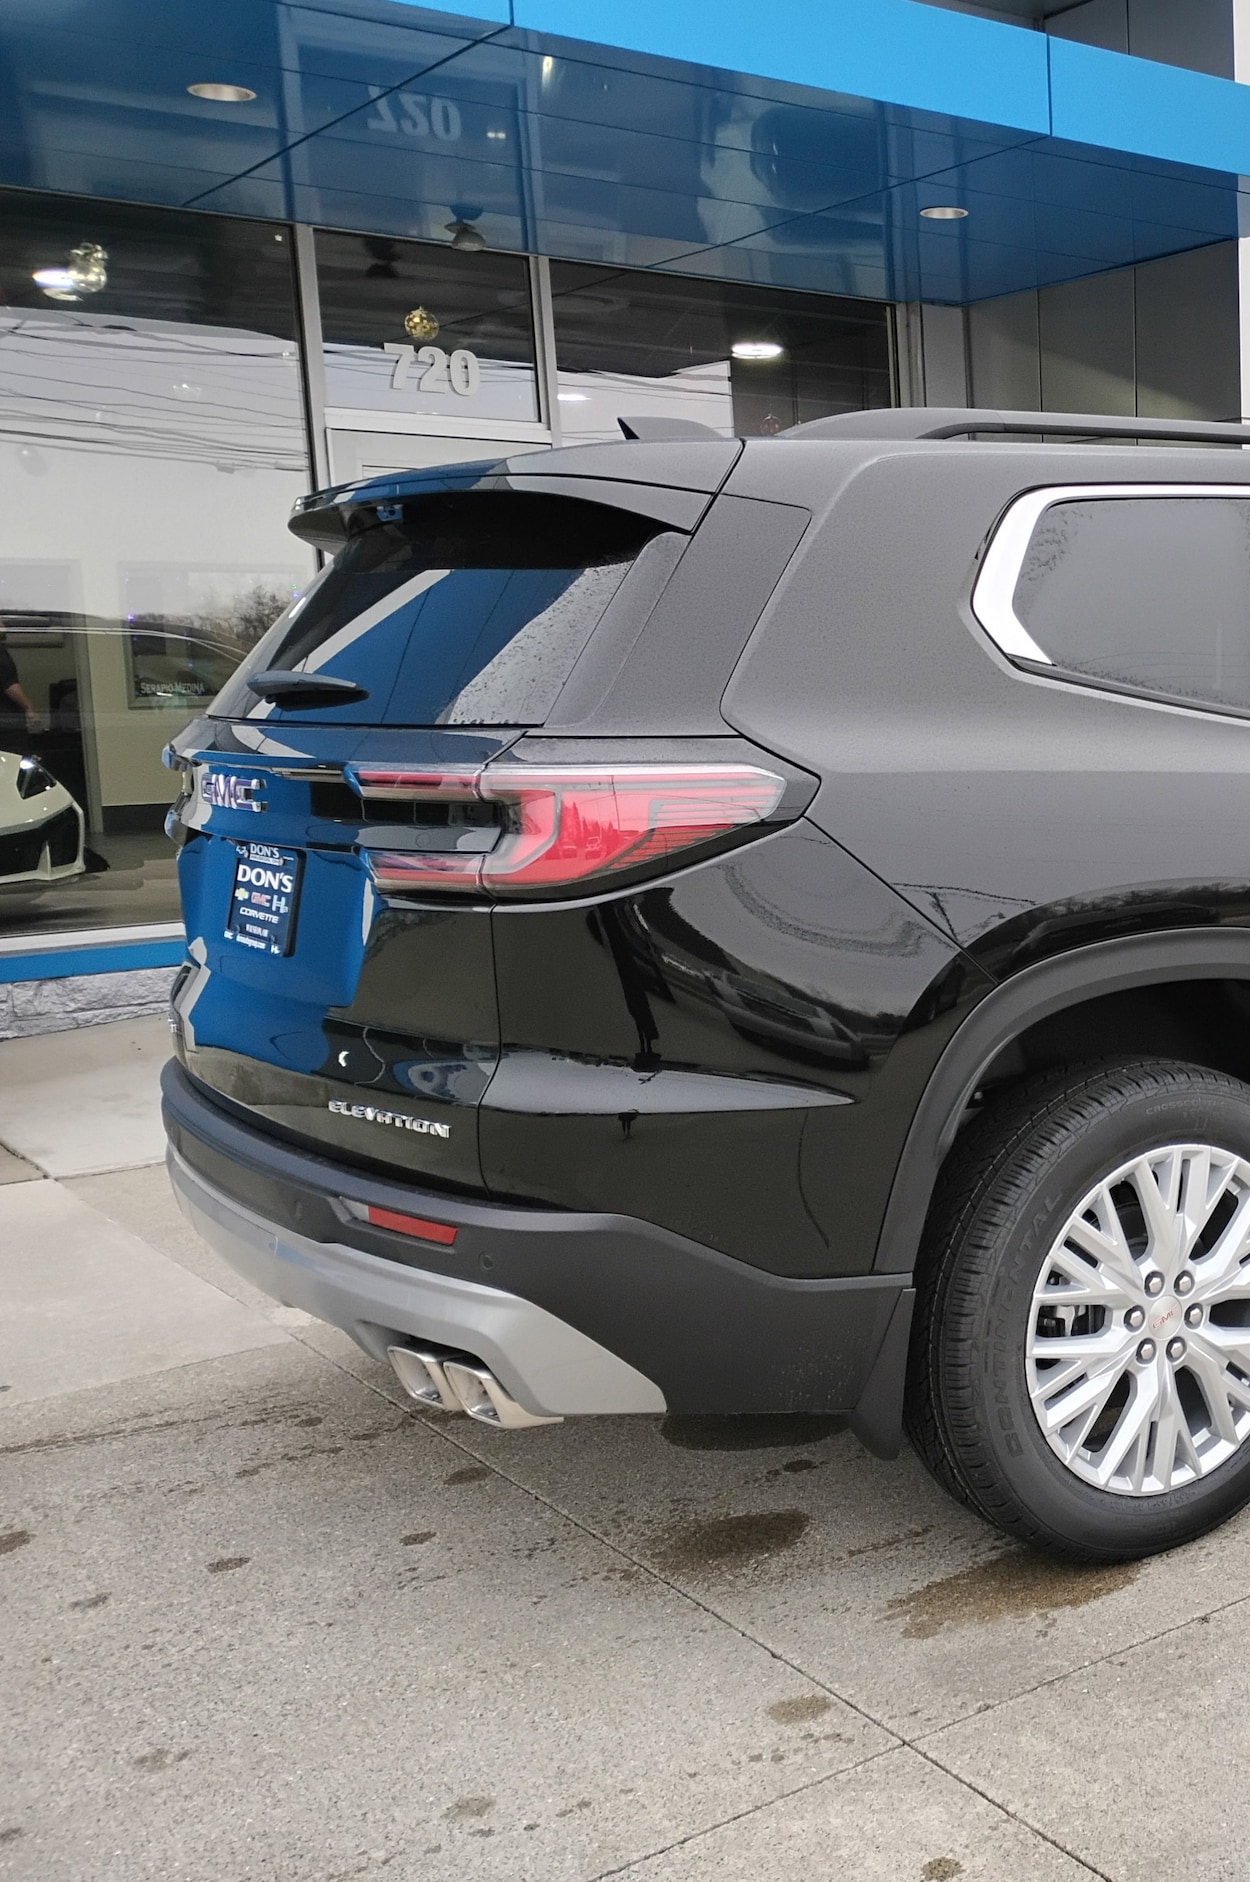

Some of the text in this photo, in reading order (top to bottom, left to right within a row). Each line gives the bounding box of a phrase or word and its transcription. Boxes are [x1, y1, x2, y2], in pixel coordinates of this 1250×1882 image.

[383, 342, 480, 397] 720
[201, 773, 264, 813] GMC
[249, 843, 280, 859] DON'S
[237, 864, 293, 893] DON'S
[240, 907, 279, 924] CORVETTE
[327, 1100, 452, 1139] ELEVATION
[993, 1194, 1062, 1458] CONTINENTAL
